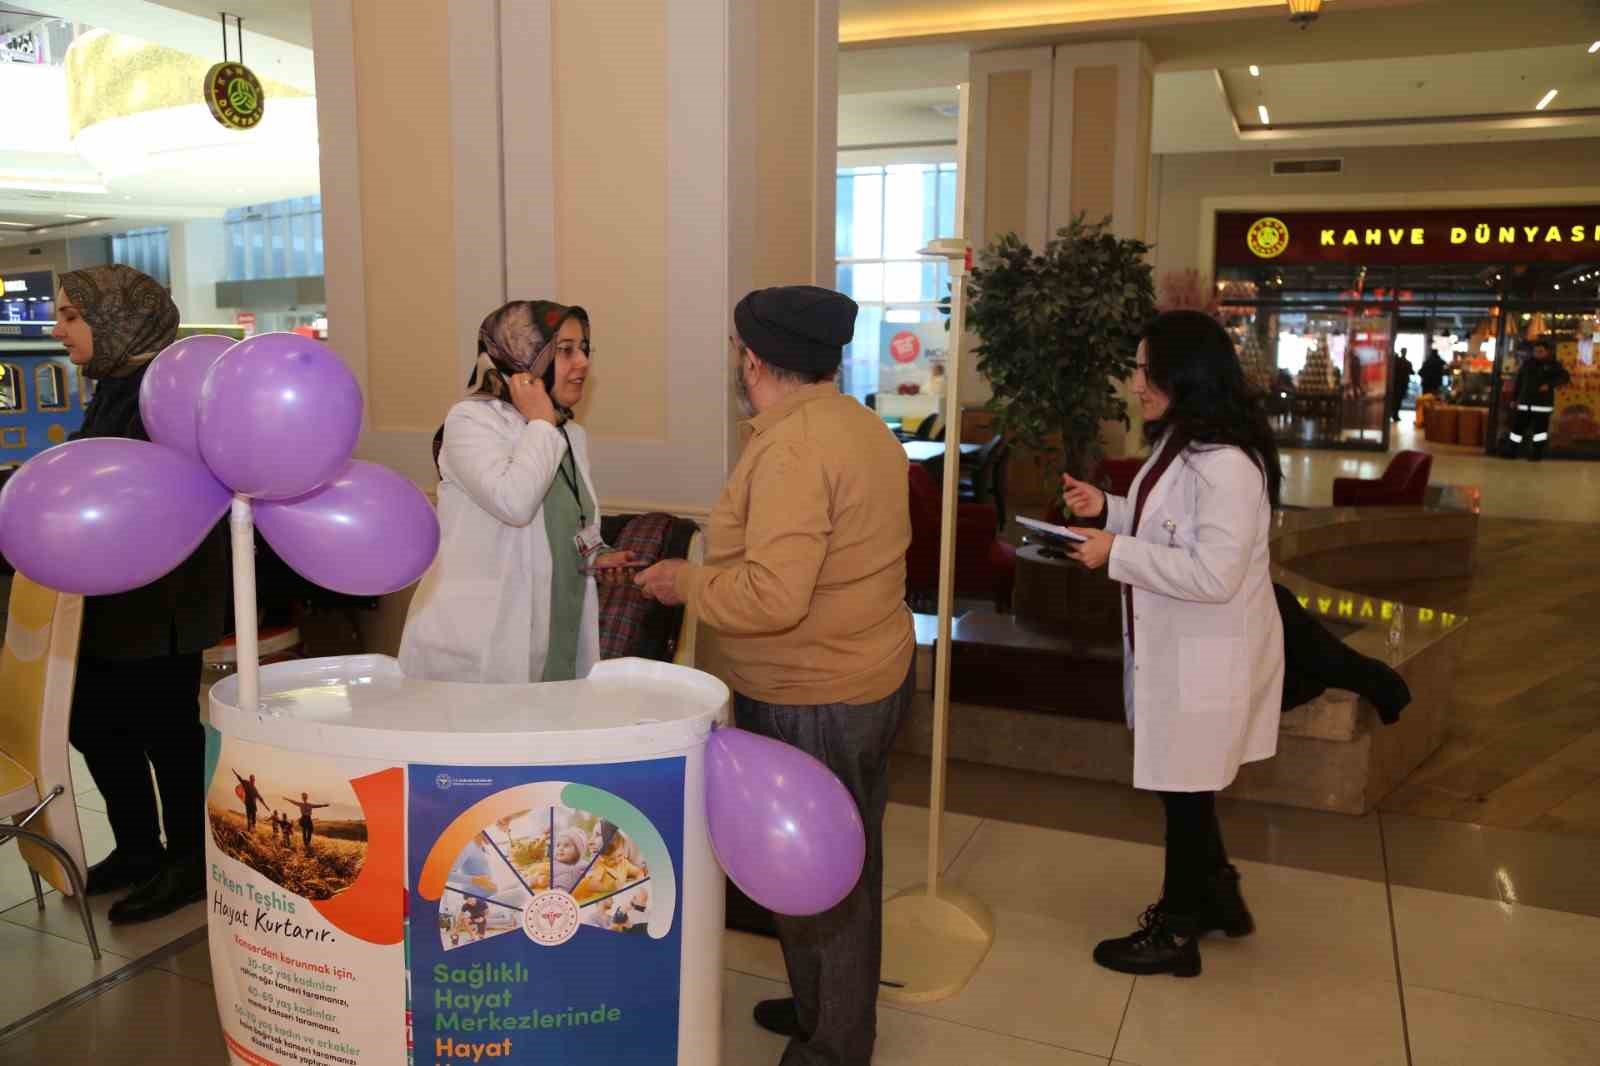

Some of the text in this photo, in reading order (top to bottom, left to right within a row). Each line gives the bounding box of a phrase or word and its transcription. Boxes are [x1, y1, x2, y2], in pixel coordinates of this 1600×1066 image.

[1320, 223, 1600, 246] KAHVE DÜNYASI
[211, 864, 296, 913] Erken Teşhis
[213, 890, 335, 942] Hayat Kurtarır.
[280, 952, 331, 974] korunmak
[433, 962, 528, 988] Sağlıklı
[435, 988, 512, 1014] Hayat
[435, 1003, 621, 1031] Merkezlerinde
[435, 1038, 512, 1063] Hayat
